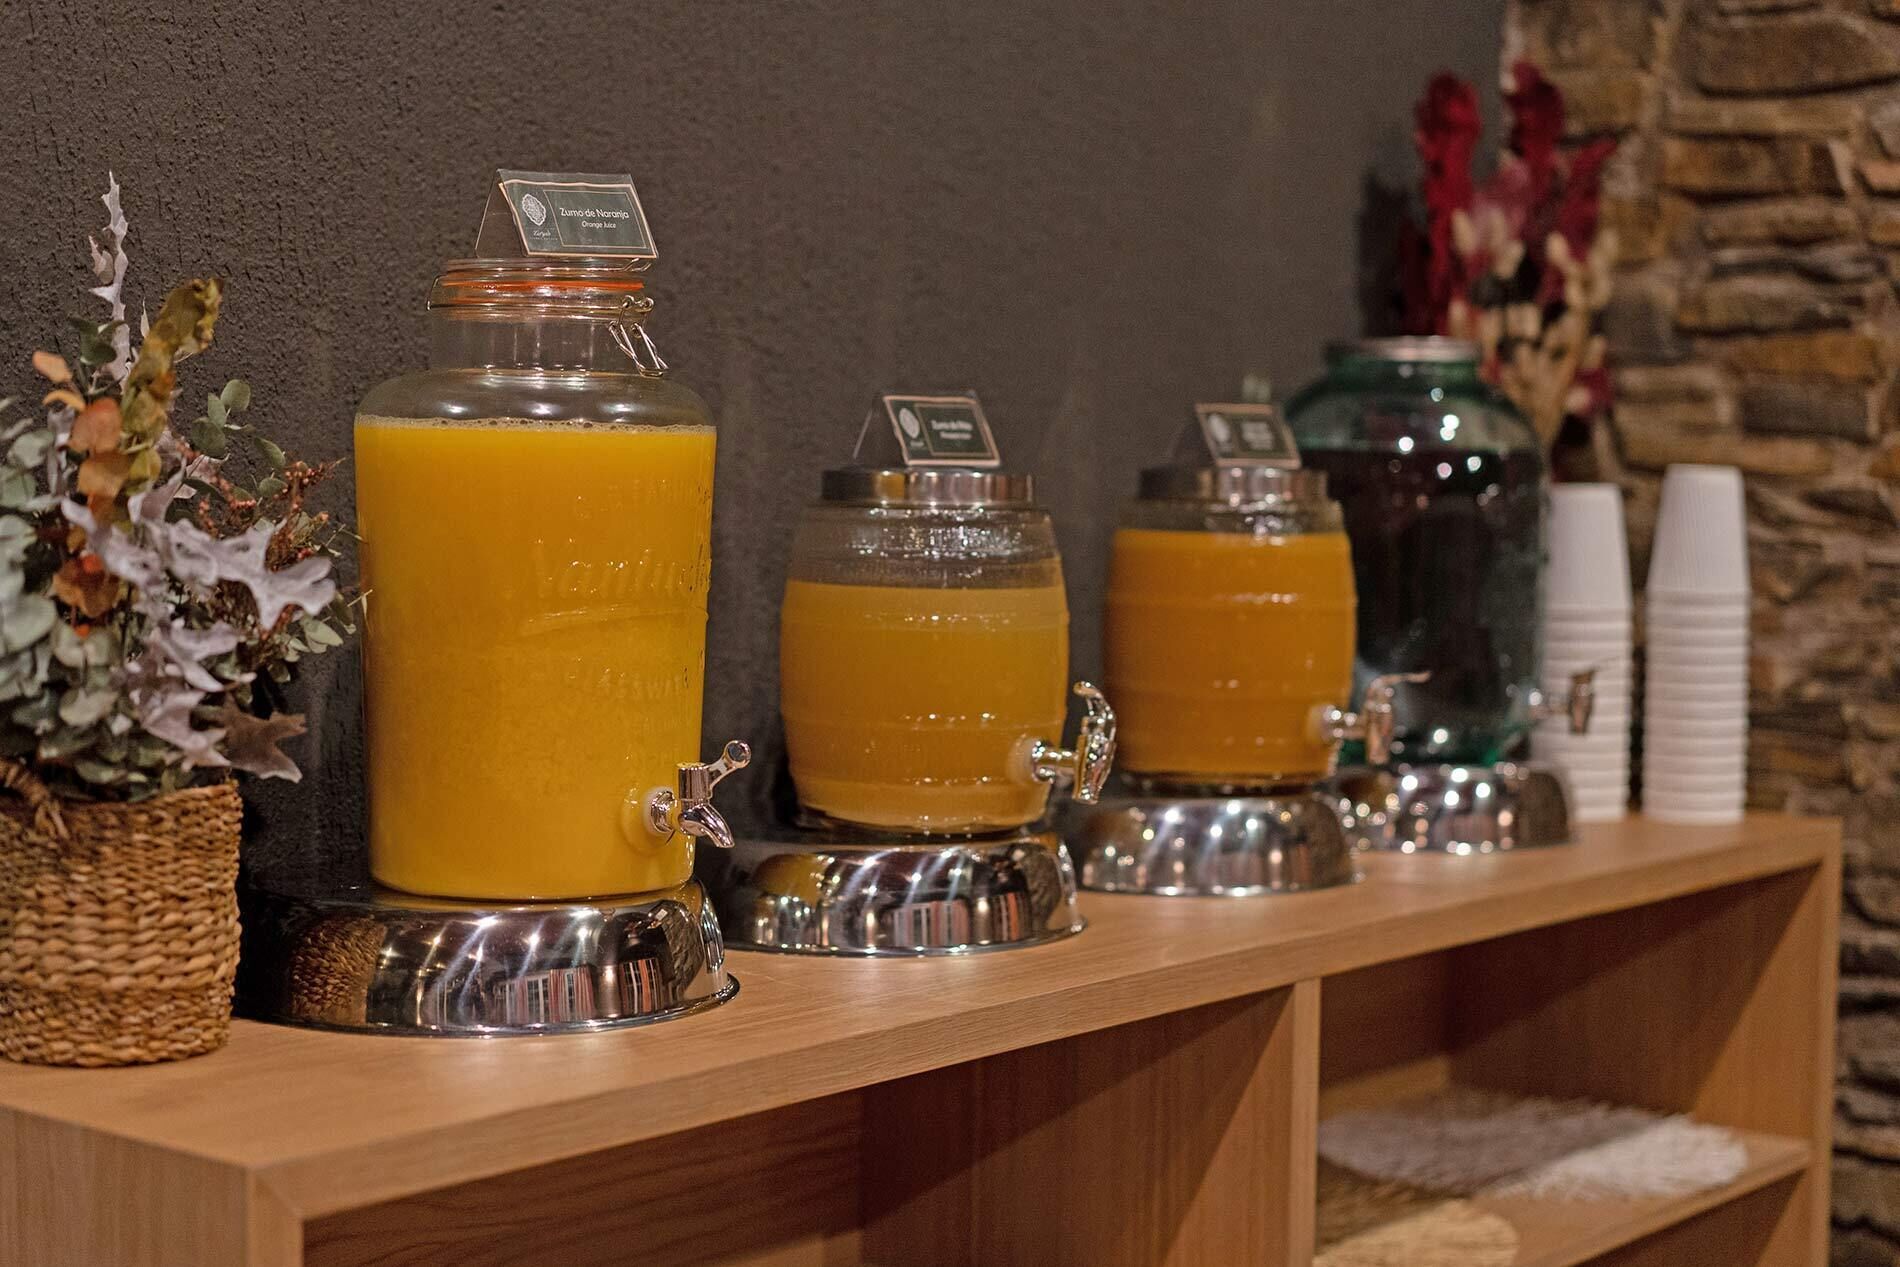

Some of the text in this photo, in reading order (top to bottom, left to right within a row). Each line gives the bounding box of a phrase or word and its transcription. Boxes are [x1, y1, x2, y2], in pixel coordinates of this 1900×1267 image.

[560, 207, 630, 220] Zumo de Naranja
[581, 220, 617, 229] Orange Juice
